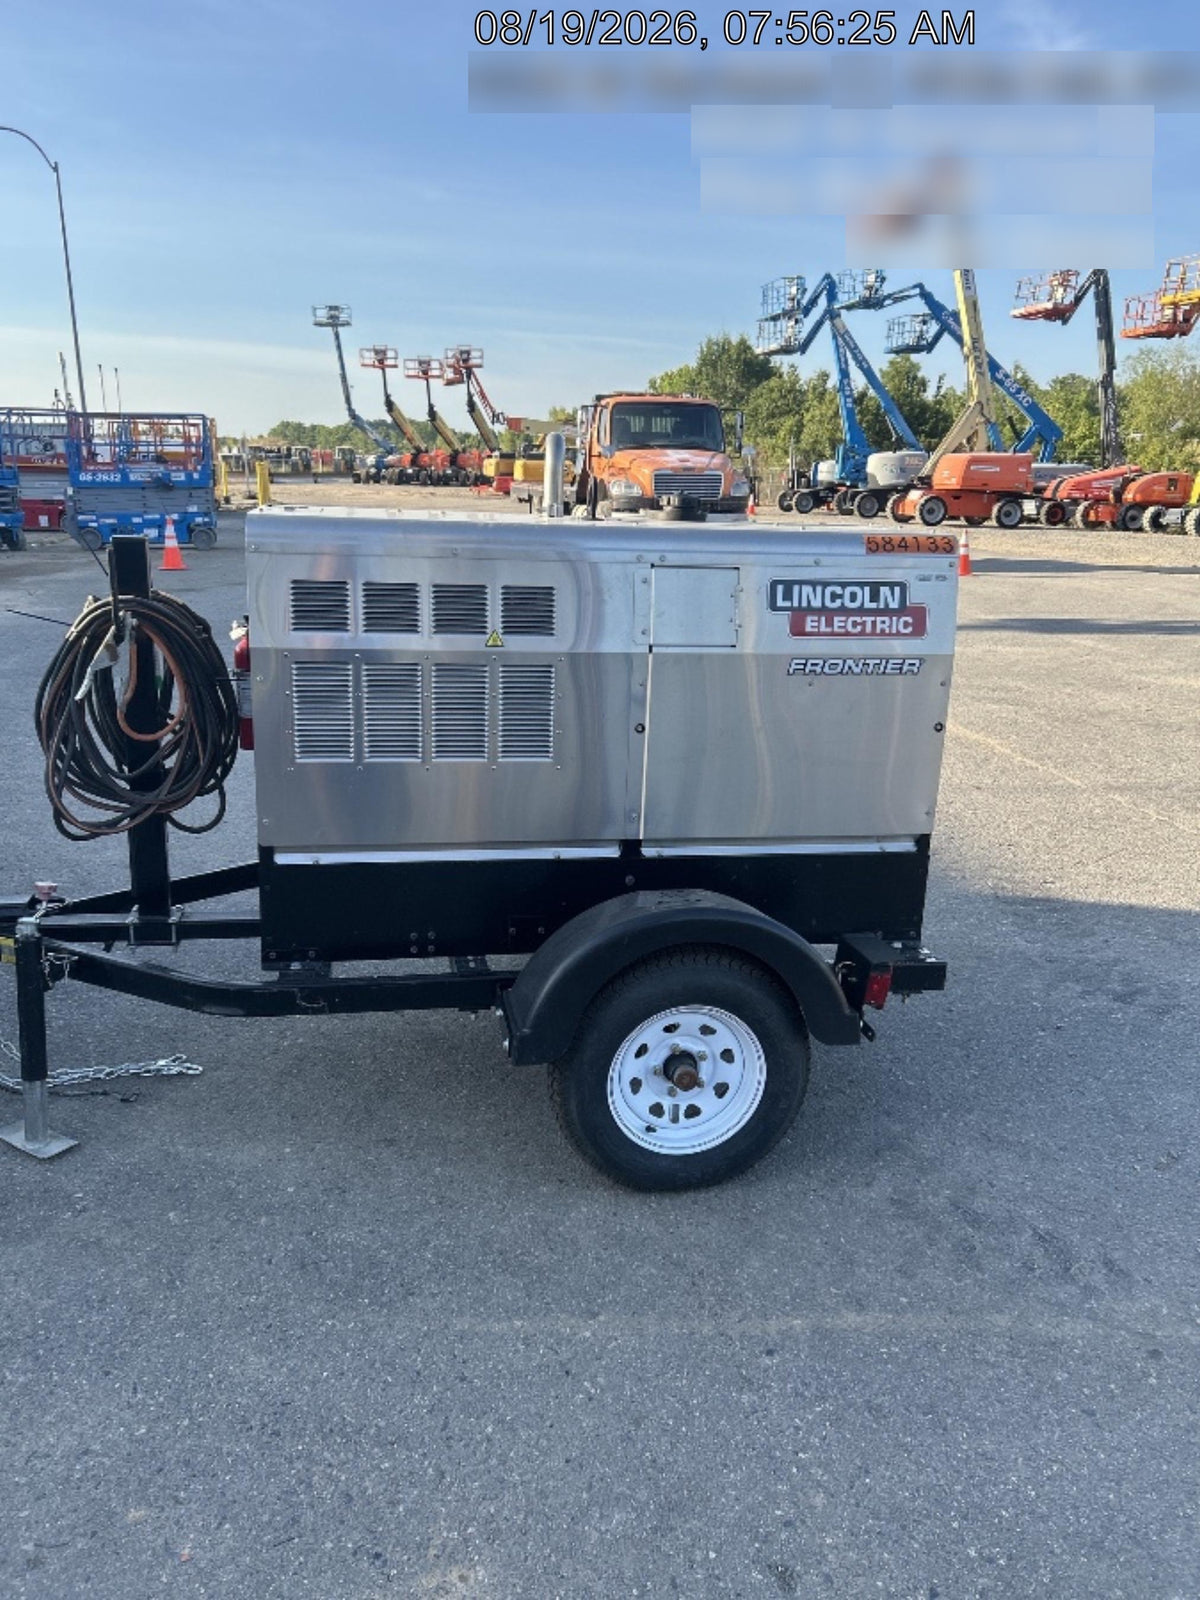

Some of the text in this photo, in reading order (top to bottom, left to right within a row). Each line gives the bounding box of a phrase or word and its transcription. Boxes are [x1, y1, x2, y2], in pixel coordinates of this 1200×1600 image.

[867, 536, 954, 553] 584133
[776, 584, 901, 609] LINCOLN
[805, 616, 913, 634] ELECTRIC
[787, 658, 922, 676] FRONTIER
